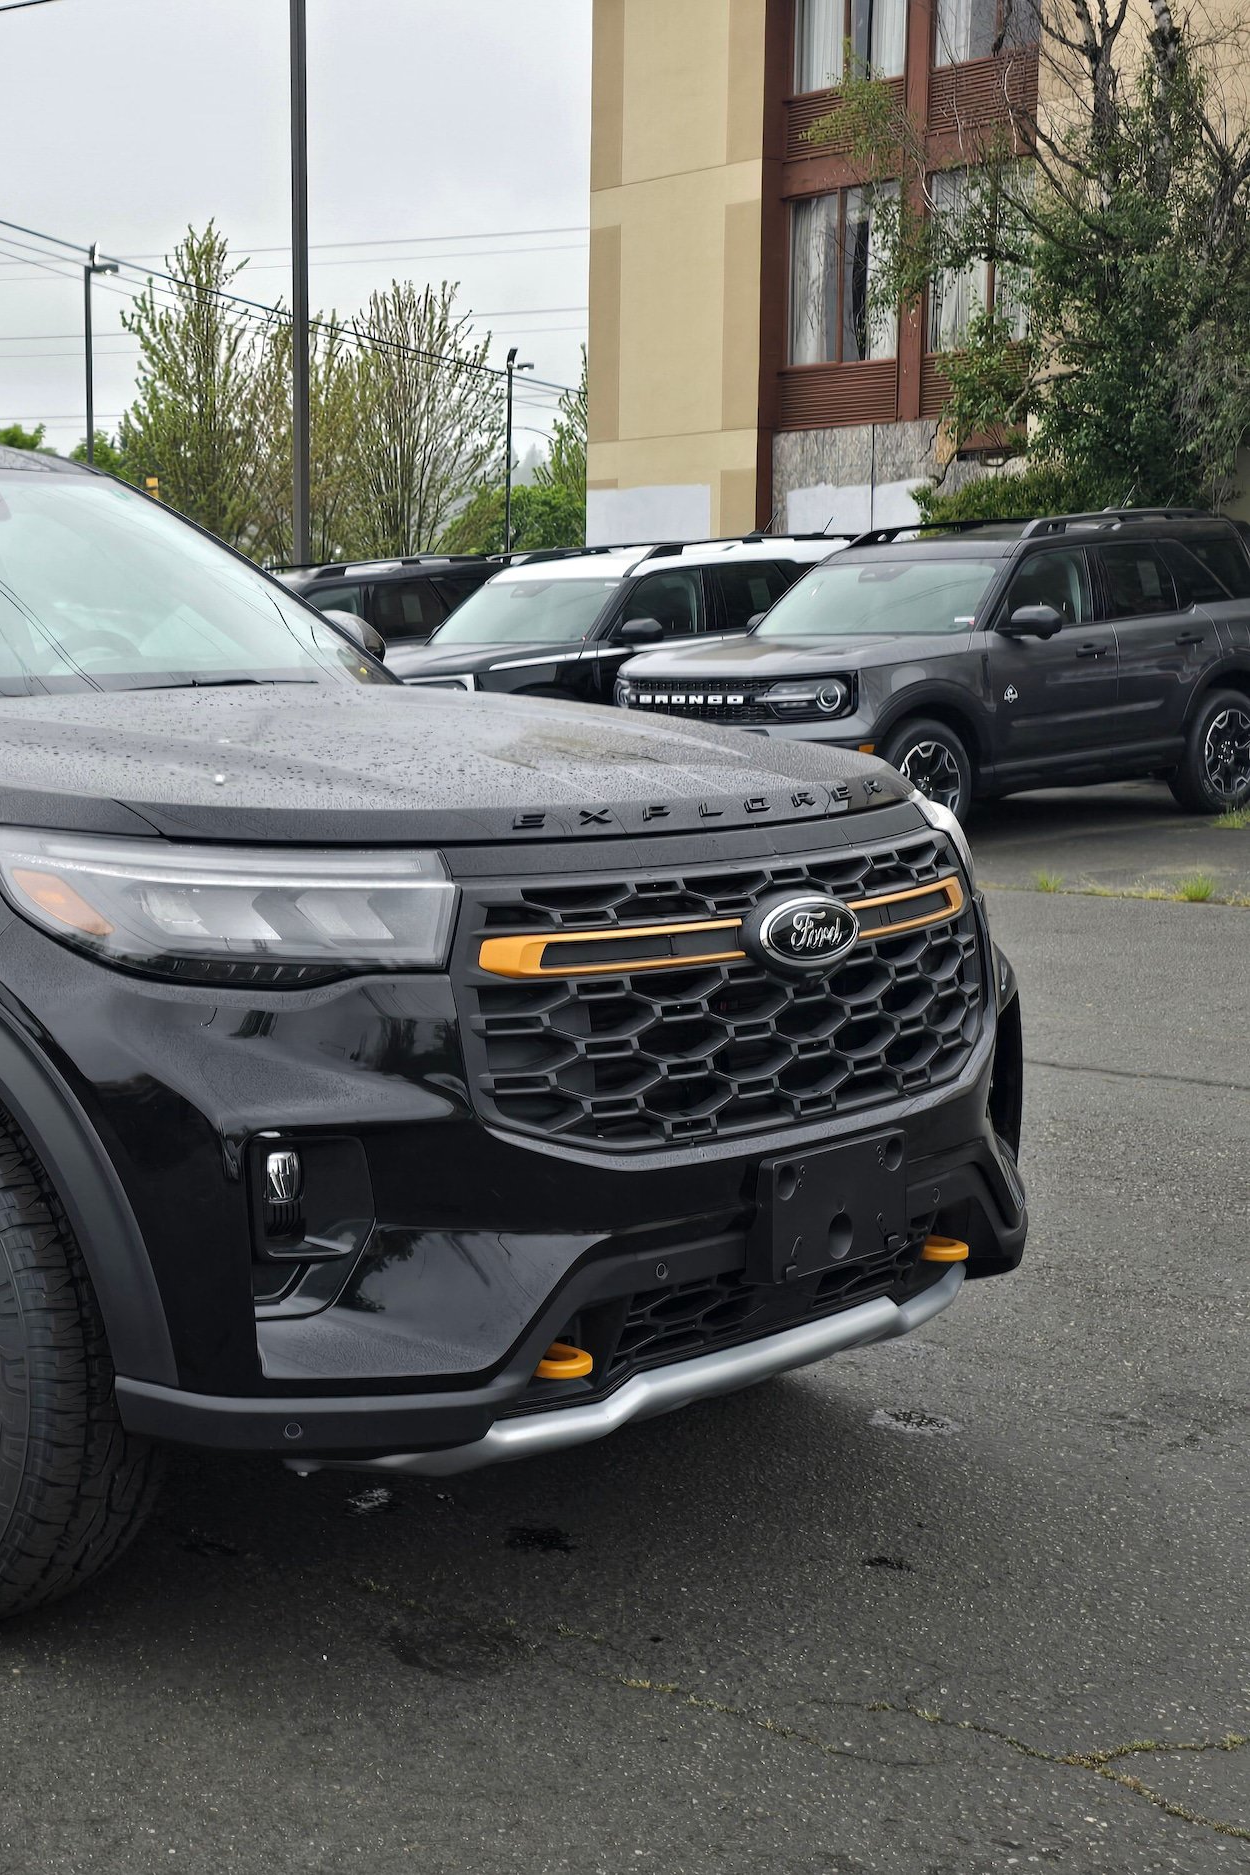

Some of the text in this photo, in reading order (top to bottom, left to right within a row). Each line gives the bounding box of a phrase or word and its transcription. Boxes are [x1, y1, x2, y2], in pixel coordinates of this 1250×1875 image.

[639, 694, 744, 705] BRONCO
[512, 780, 883, 829] EXPLORER
[791, 911, 848, 951] Ford
